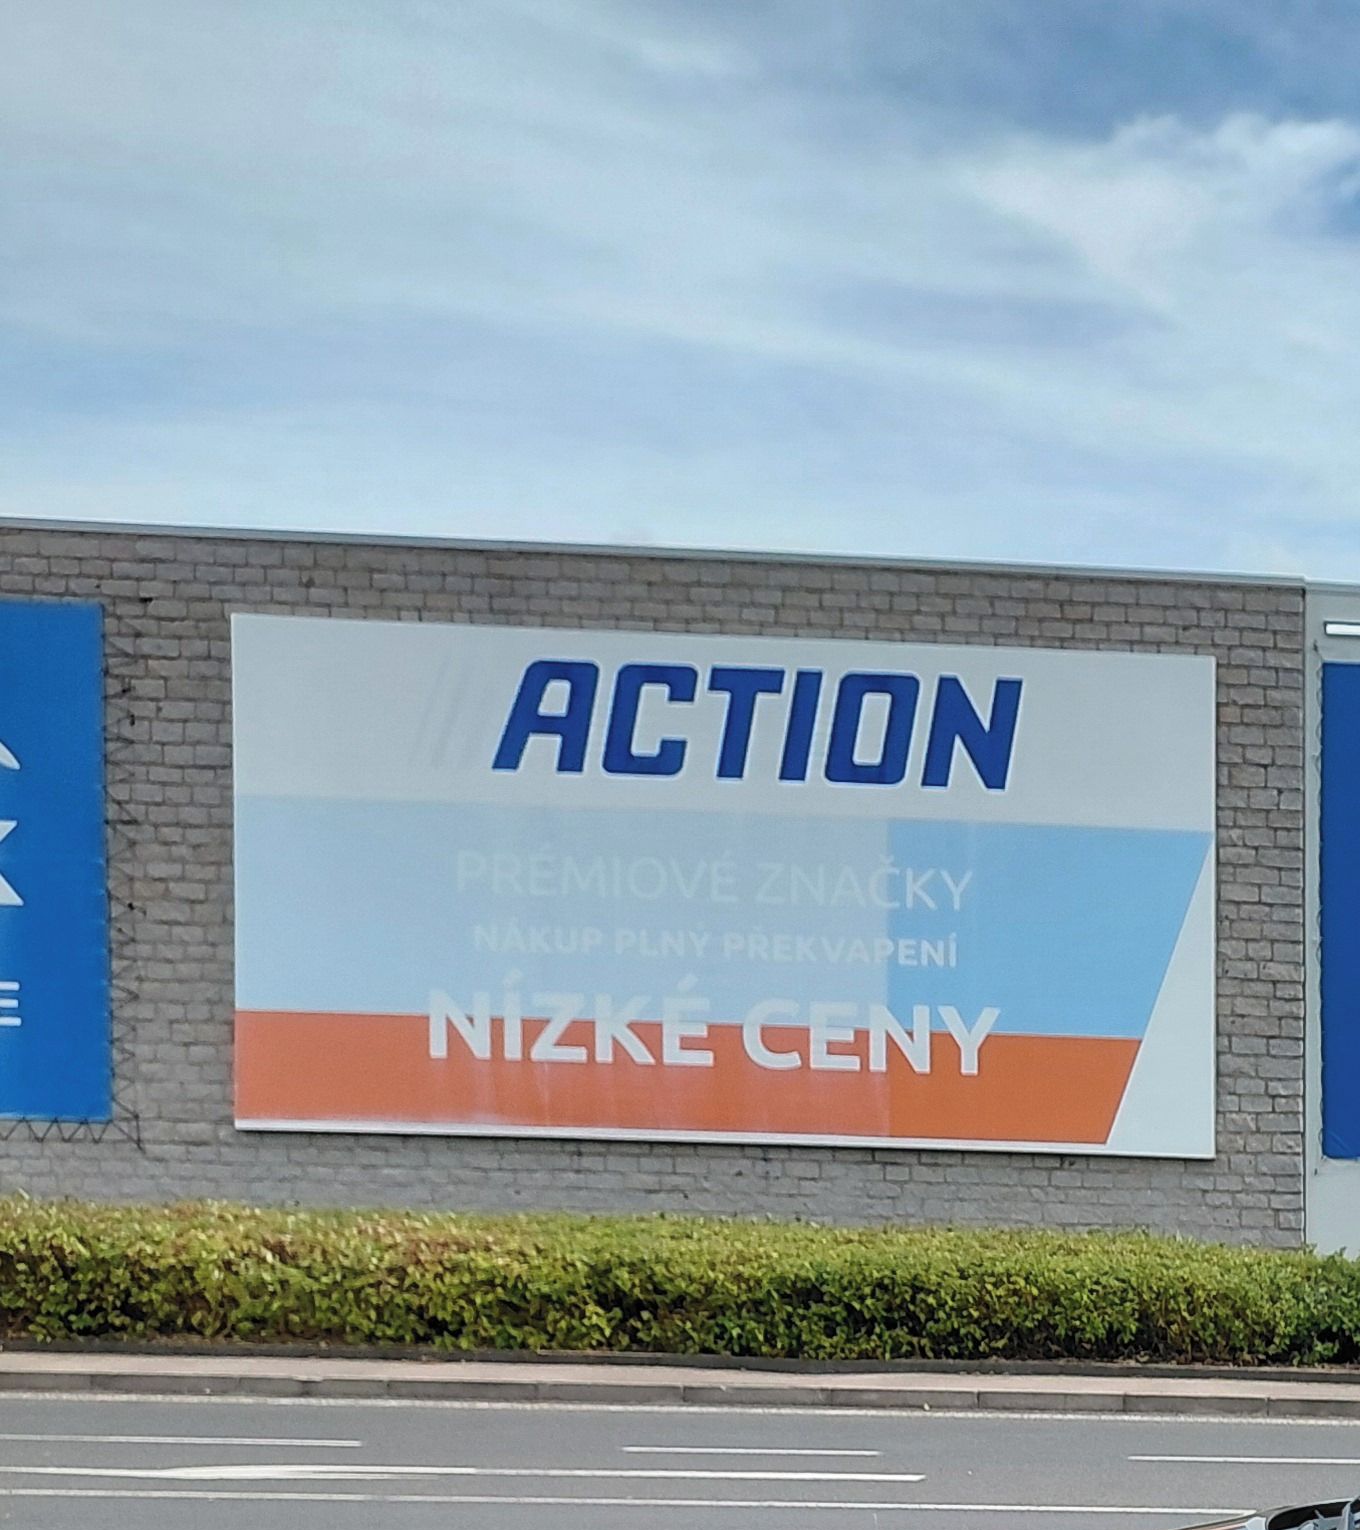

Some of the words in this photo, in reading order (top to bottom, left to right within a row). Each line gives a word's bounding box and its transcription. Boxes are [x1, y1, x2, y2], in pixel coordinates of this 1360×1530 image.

[491, 659, 1023, 792] ACTION
[456, 843, 738, 904] PRÉMIOVÉ
[755, 854, 972, 911] ZNAČKY
[474, 919, 602, 956] NÁKUP
[616, 925, 710, 958] PLNÝ
[722, 928, 957, 967] PŘEKVAPENÍ
[428, 970, 715, 1066] NÍZKÉ
[741, 997, 1001, 1076] CENY
